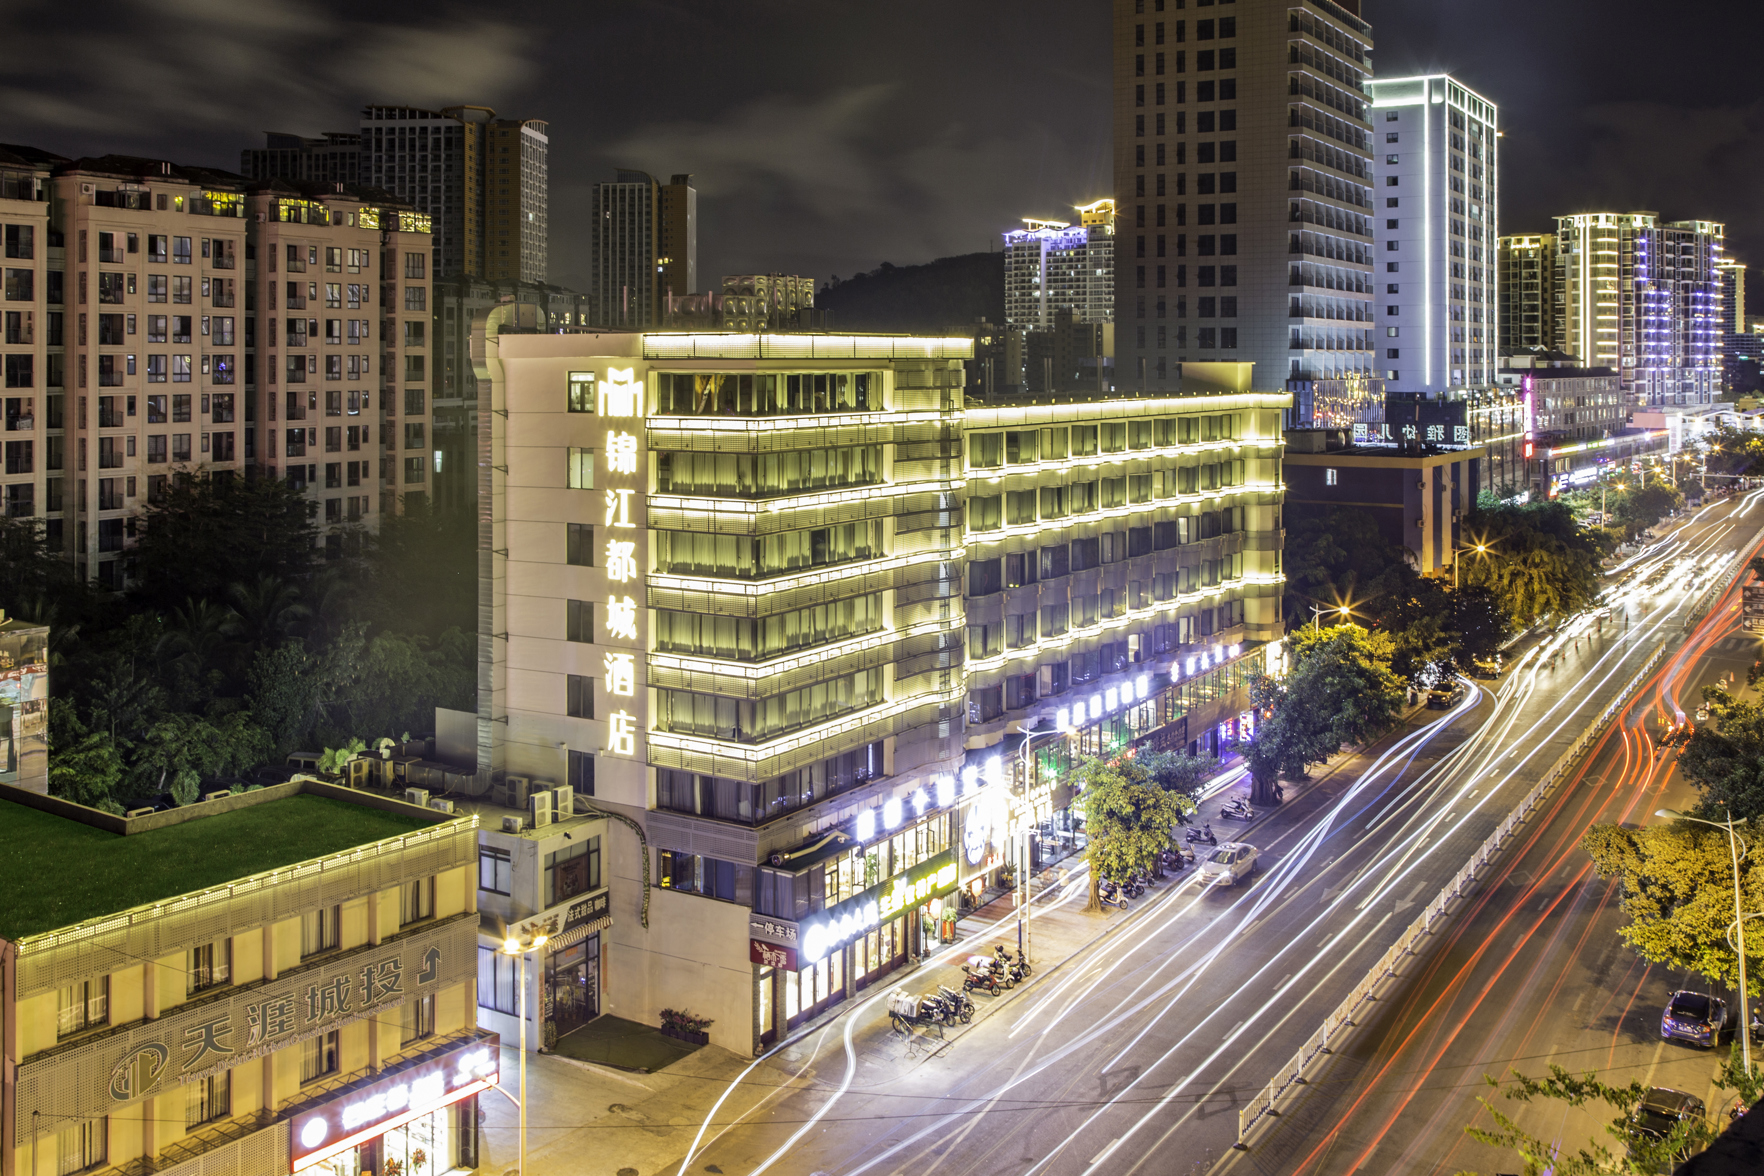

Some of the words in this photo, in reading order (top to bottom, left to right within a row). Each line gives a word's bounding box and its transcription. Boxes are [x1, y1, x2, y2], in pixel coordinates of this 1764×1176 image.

[604, 429, 637, 756] 锦江都城酒店
[567, 900, 593, 923] 法式甜品
[764, 921, 797, 941] 停车场
[179, 1065, 217, 1087] Tianya
[217, 1049, 258, 1073] District
[258, 1039, 290, 1058] Urban
[290, 1015, 353, 1046] Construction
[353, 995, 406, 1021] Investment
[181, 957, 405, 1072] 天涯城投
